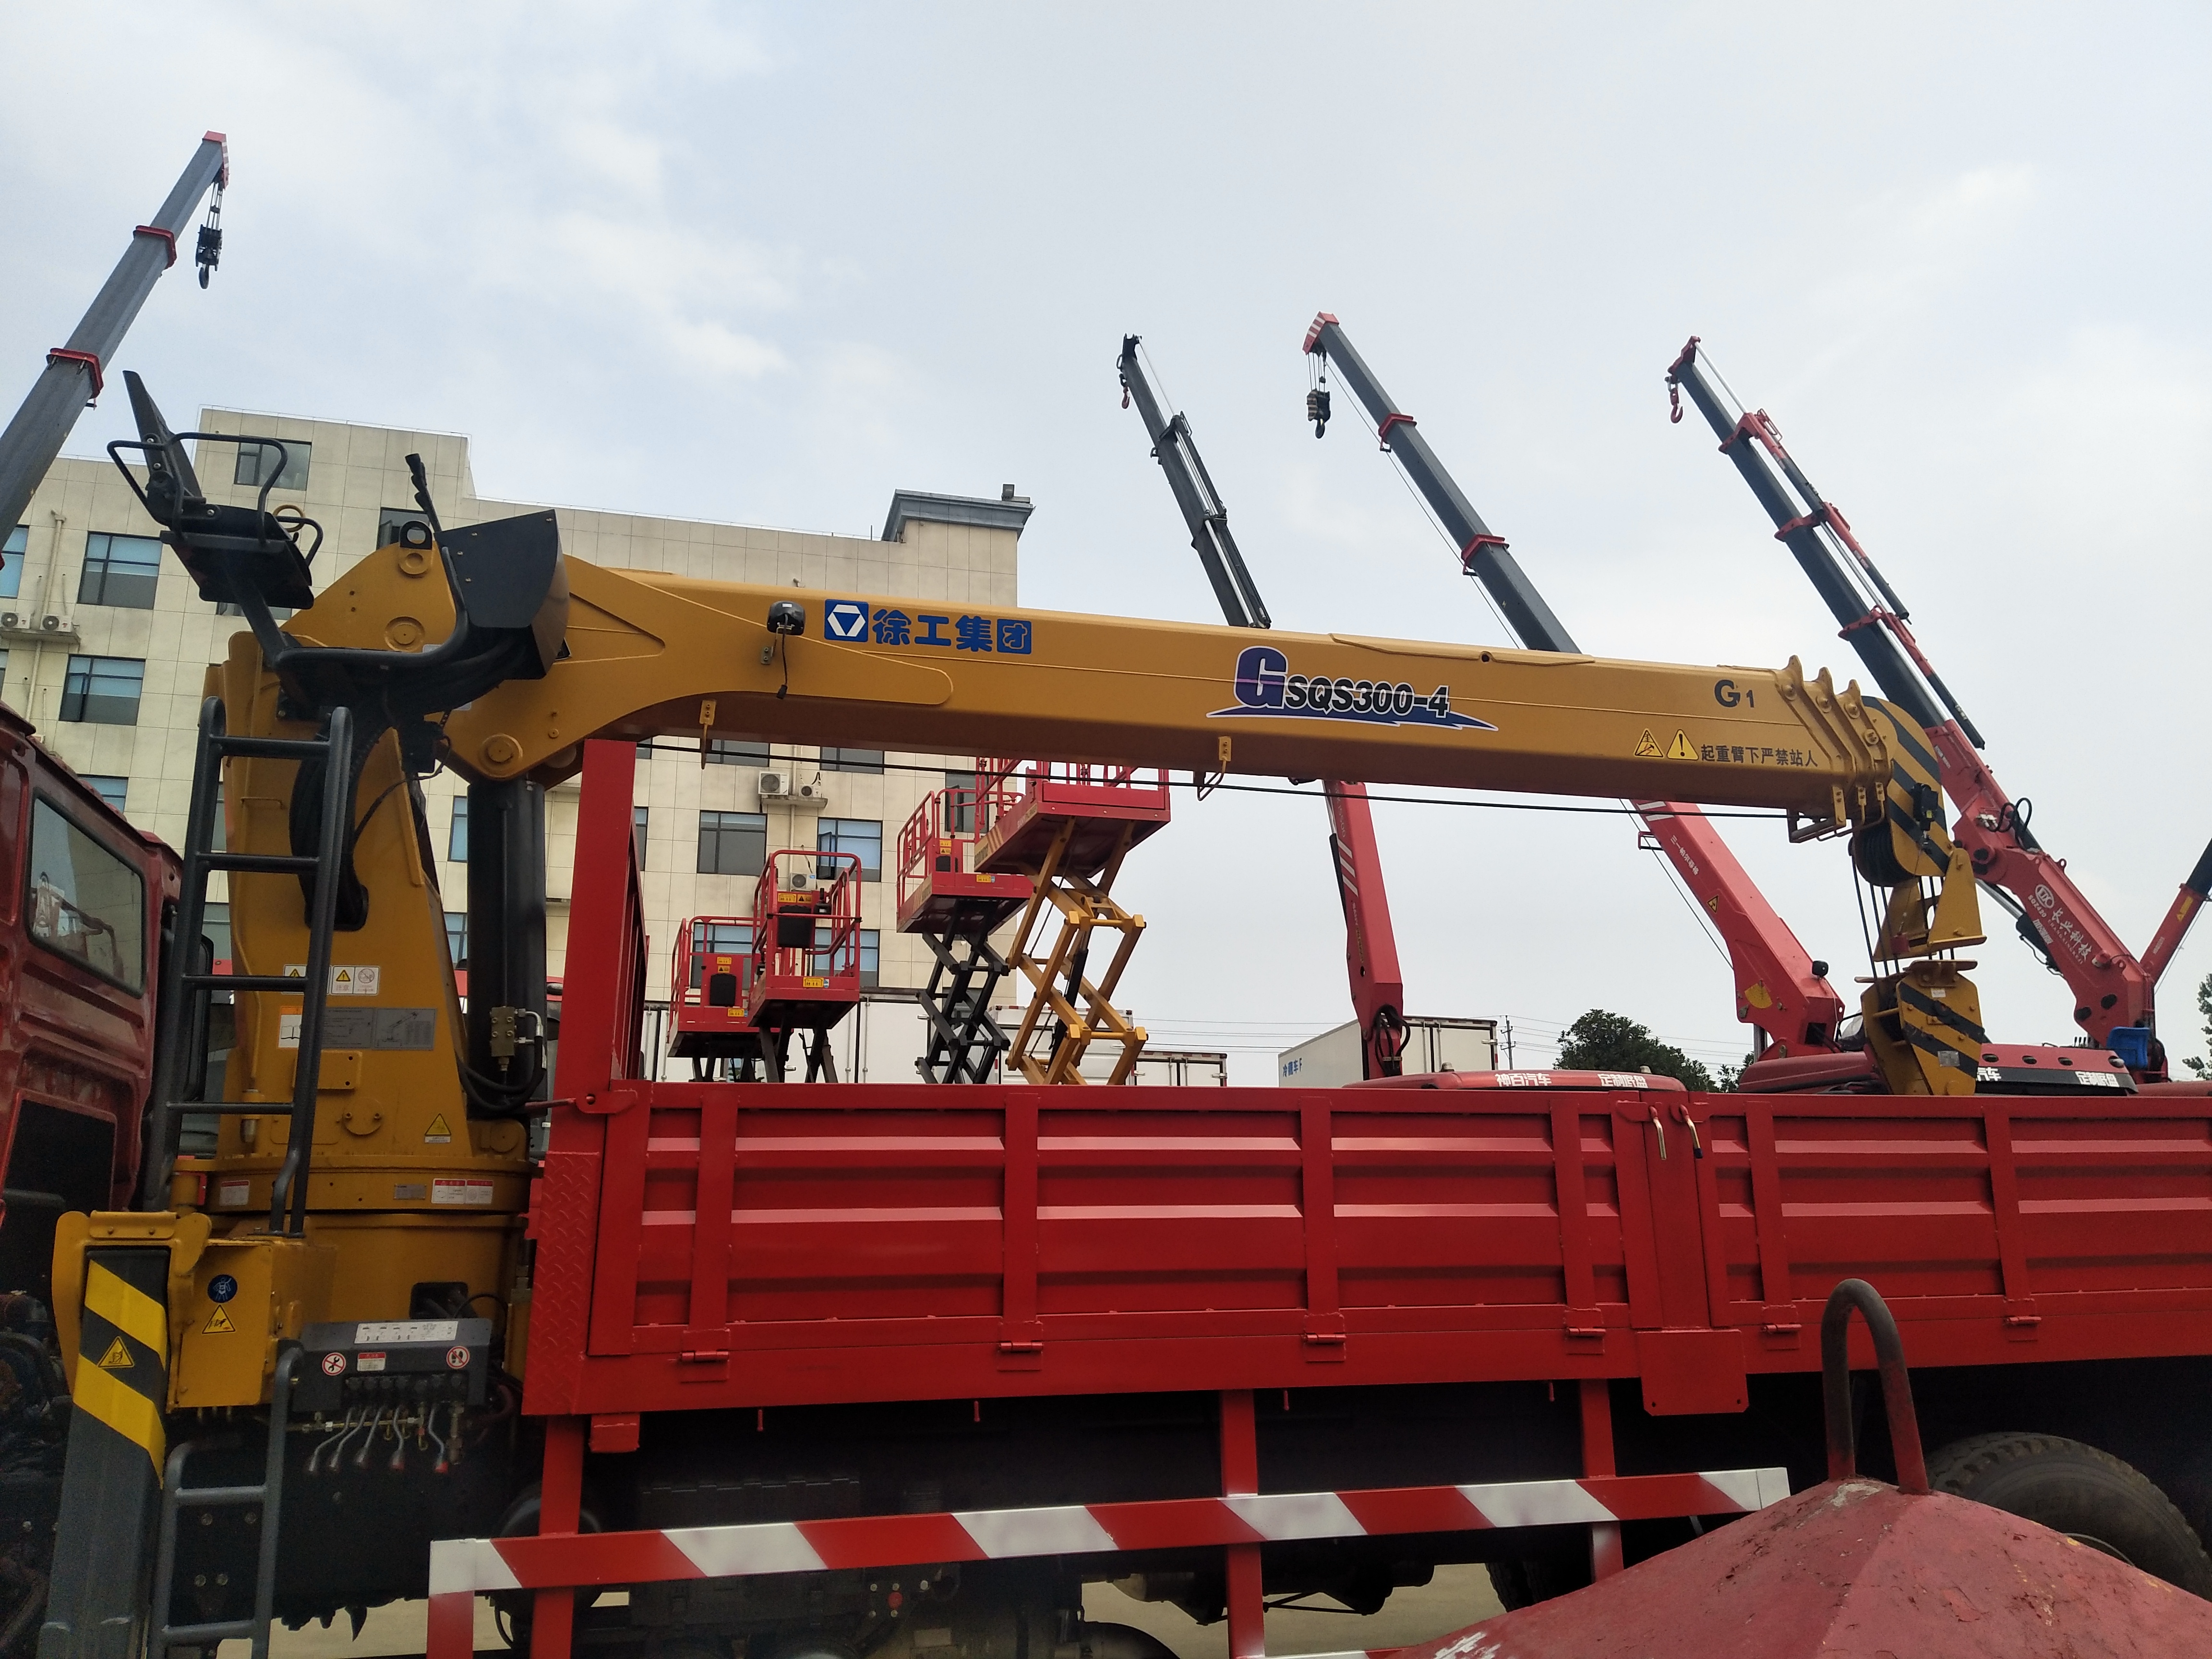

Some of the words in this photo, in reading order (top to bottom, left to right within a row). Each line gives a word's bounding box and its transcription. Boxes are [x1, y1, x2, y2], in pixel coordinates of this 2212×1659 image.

[872, 609, 1032, 654] 徐工集团
[1701, 744, 1818, 767] 起重臂下严禁站人
[2028, 894, 2047, 918] SQZ420
[1495, 1073, 1552, 1087] 神百汽车
[1598, 1073, 1648, 1088] 定制底盘
